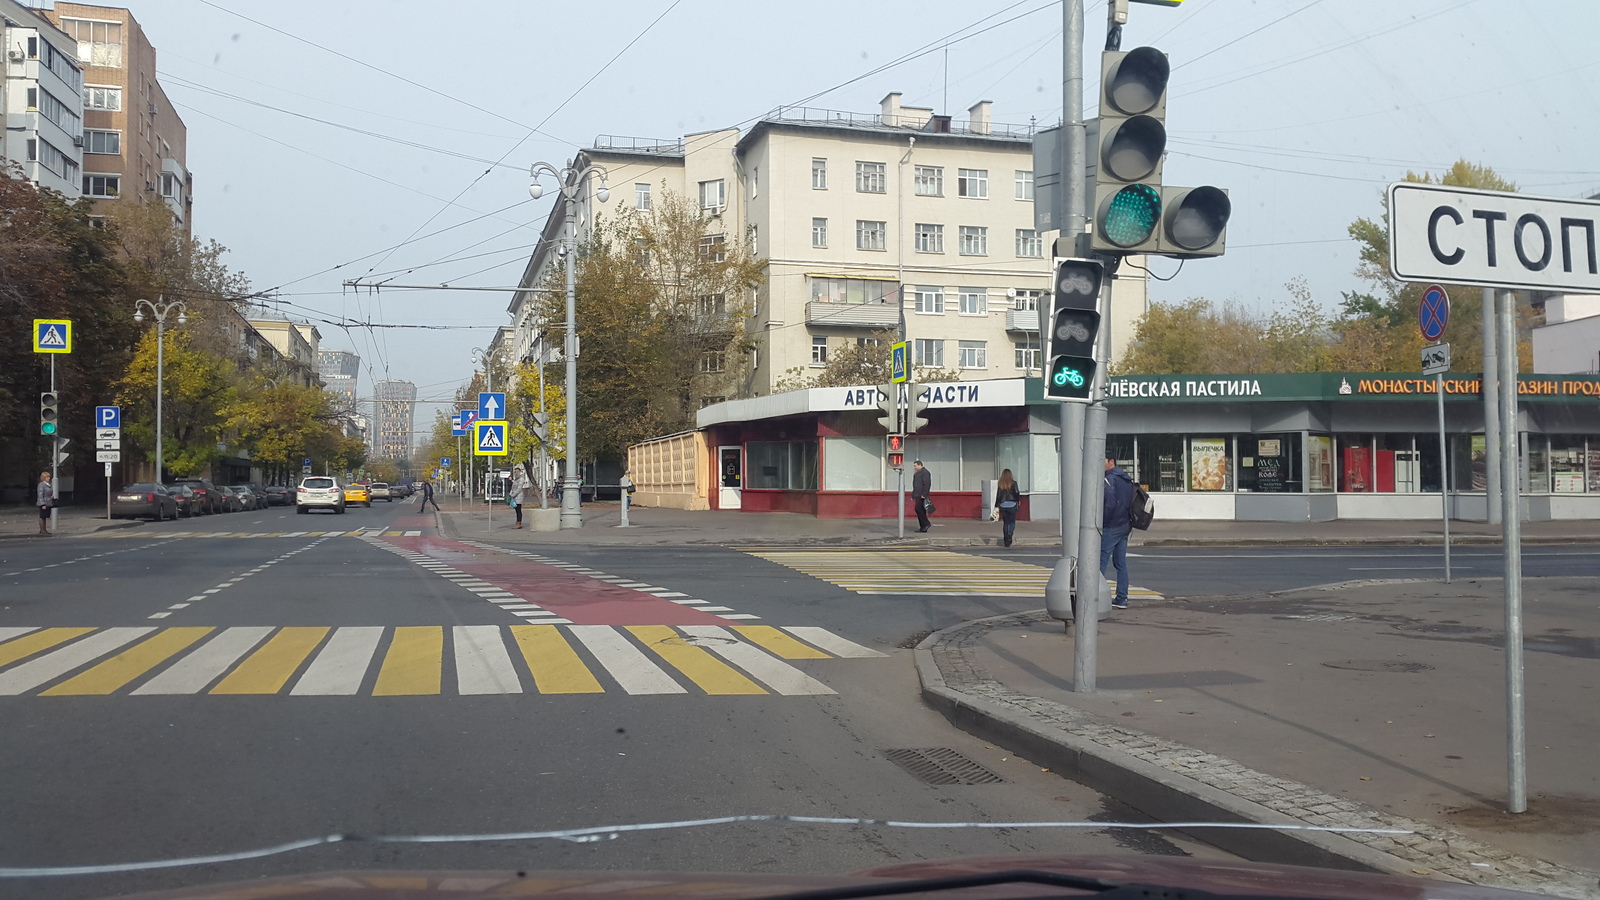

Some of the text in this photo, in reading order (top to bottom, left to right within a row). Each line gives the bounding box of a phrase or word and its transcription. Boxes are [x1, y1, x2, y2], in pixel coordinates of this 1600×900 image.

[1428, 205, 1598, 274] СТОП
[1104, 379, 1261, 397] ЛЁВСКАЯ ПАСТИЛА
[102, 408, 116, 426] P
